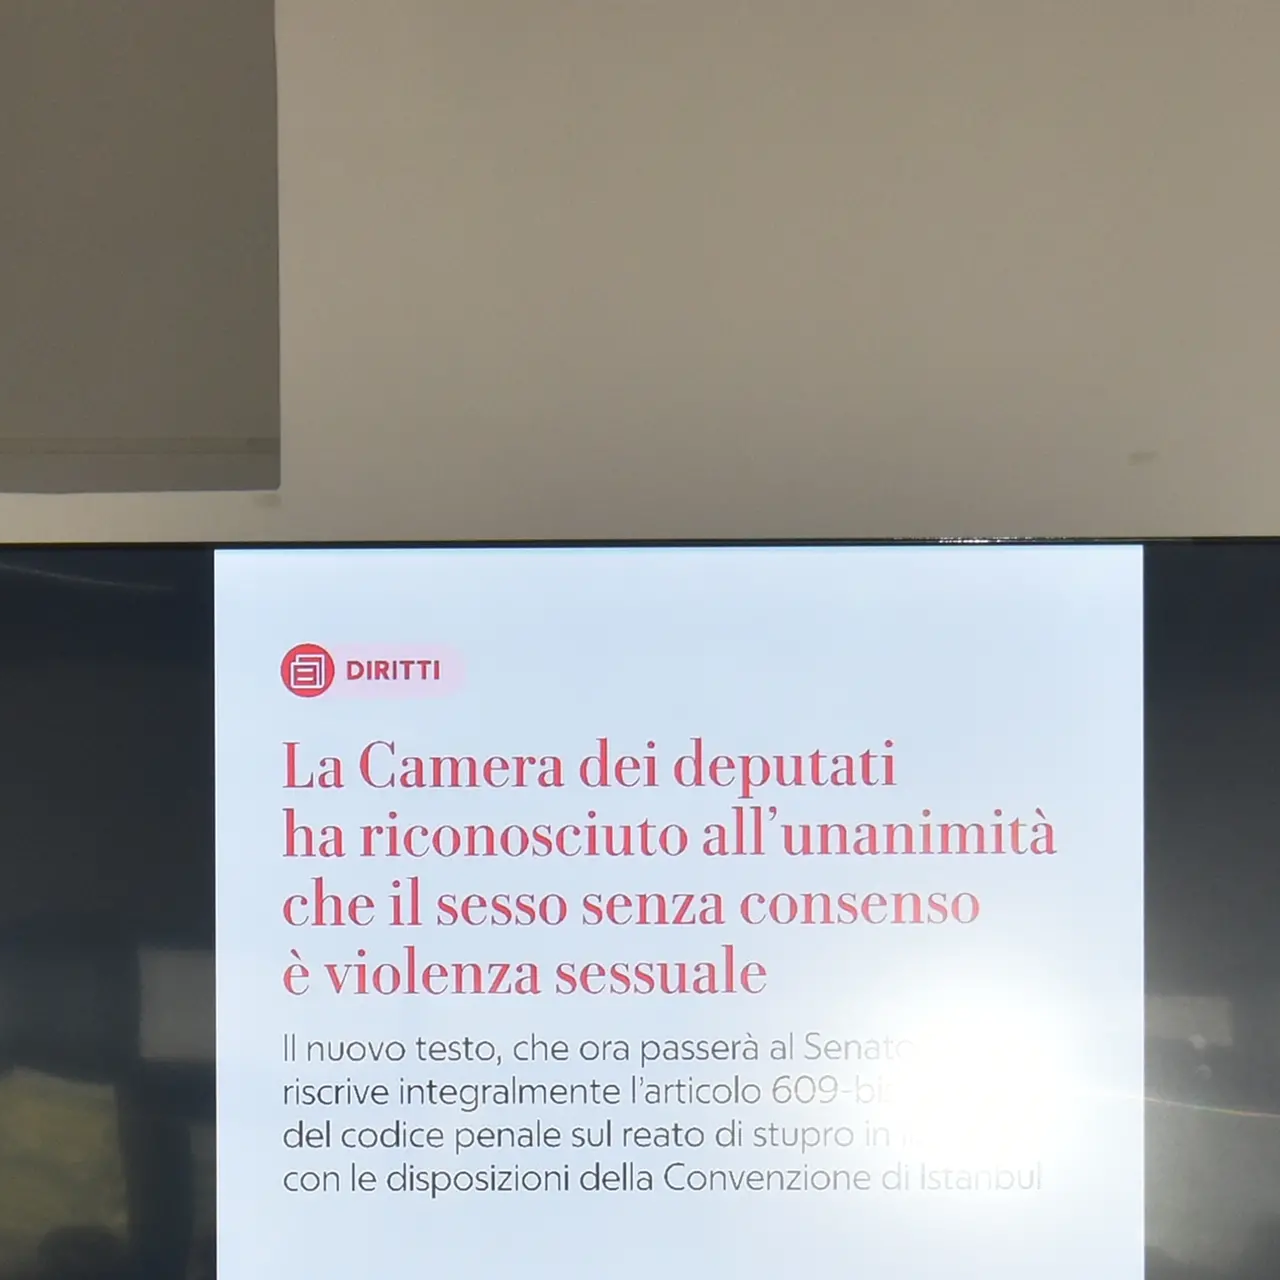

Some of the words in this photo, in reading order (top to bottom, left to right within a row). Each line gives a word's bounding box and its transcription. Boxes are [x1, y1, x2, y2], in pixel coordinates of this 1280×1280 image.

[346, 659, 440, 681] DIRITTI
[282, 741, 345, 789] La
[359, 740, 565, 789] Camera
[579, 737, 659, 788] dei
[673, 737, 897, 800] deputati
[282, 807, 346, 858] ha
[359, 810, 688, 858] riconosciuto
[282, 876, 375, 927] che
[388, 875, 423, 926] il
[437, 893, 568, 926] sesso
[582, 893, 726, 926] senza
[740, 892, 980, 925] consenso
[282, 948, 310, 996] è
[323, 945, 542, 996] violenza
[555, 944, 767, 995] sessuale
